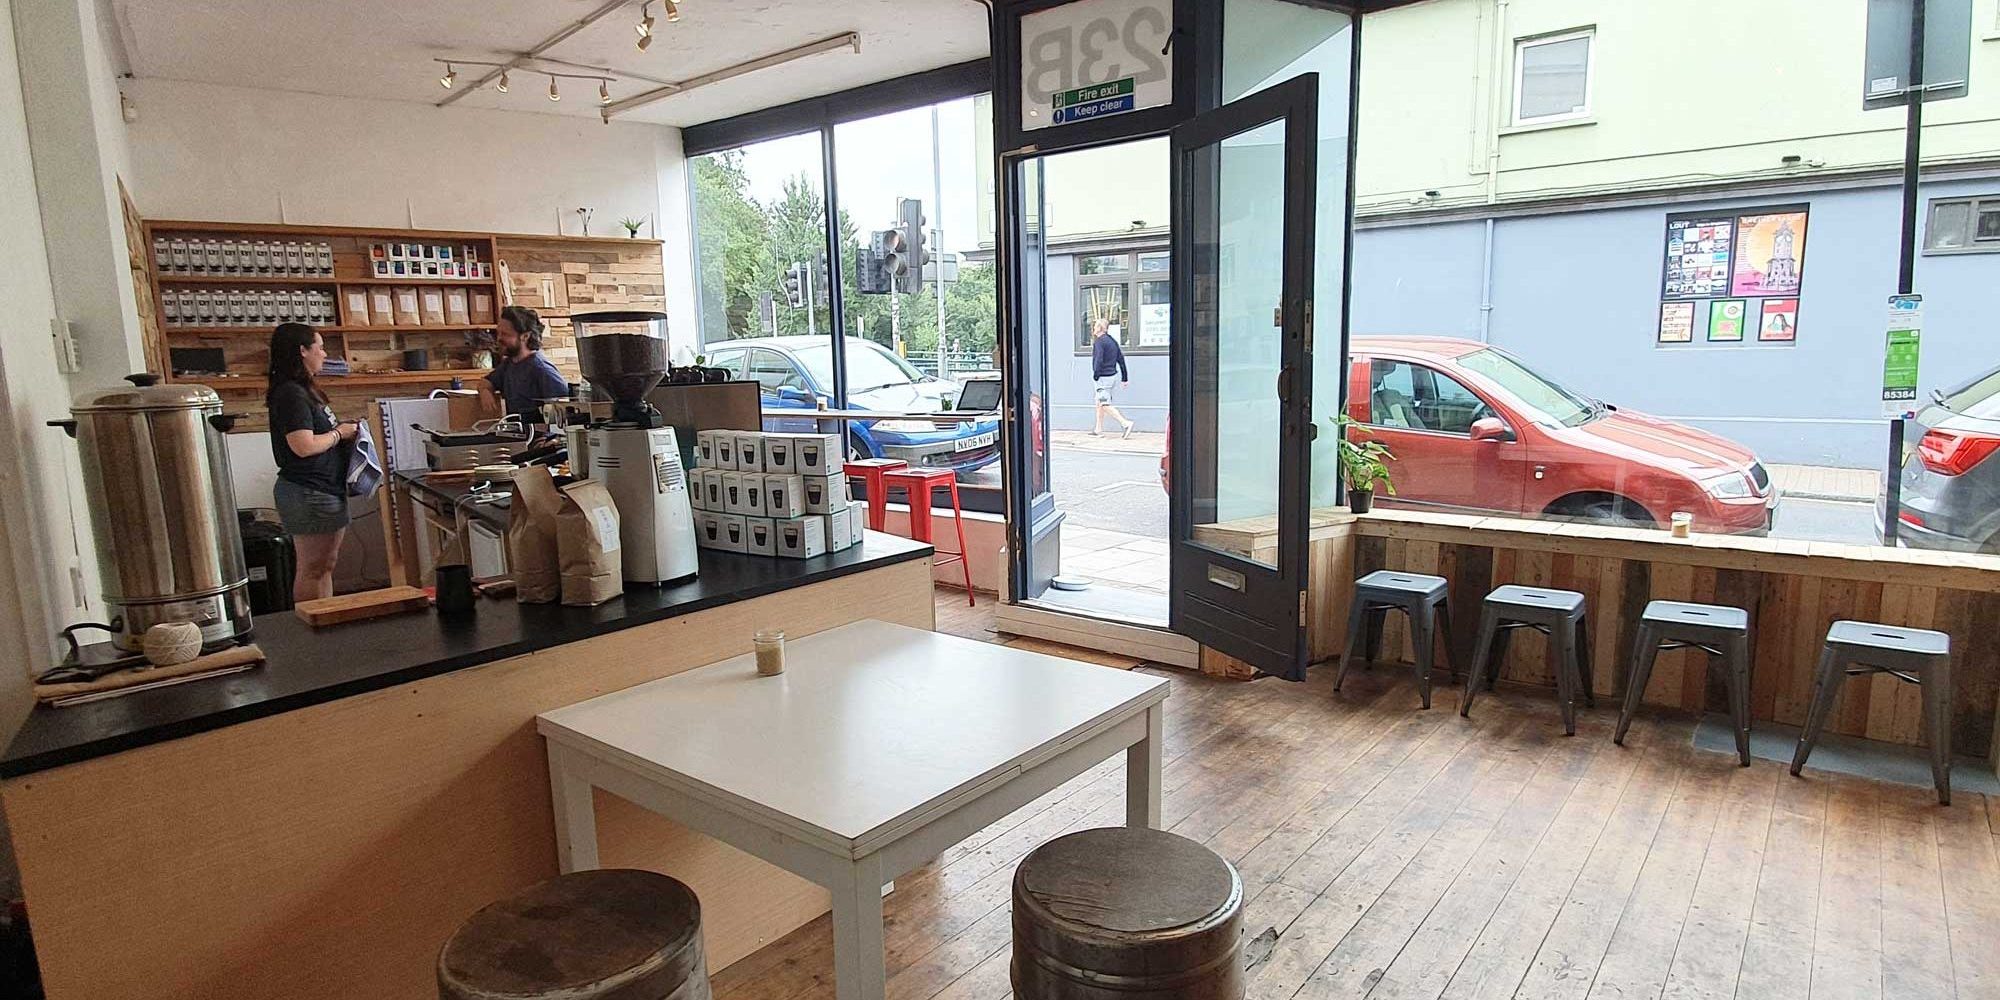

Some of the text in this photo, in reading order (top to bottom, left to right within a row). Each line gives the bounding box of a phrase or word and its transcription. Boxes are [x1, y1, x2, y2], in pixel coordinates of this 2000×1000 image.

[1077, 83, 1119, 102] Fire exit
[1074, 98, 1123, 118] Keep clear
[1884, 390, 1915, 399] 85384
